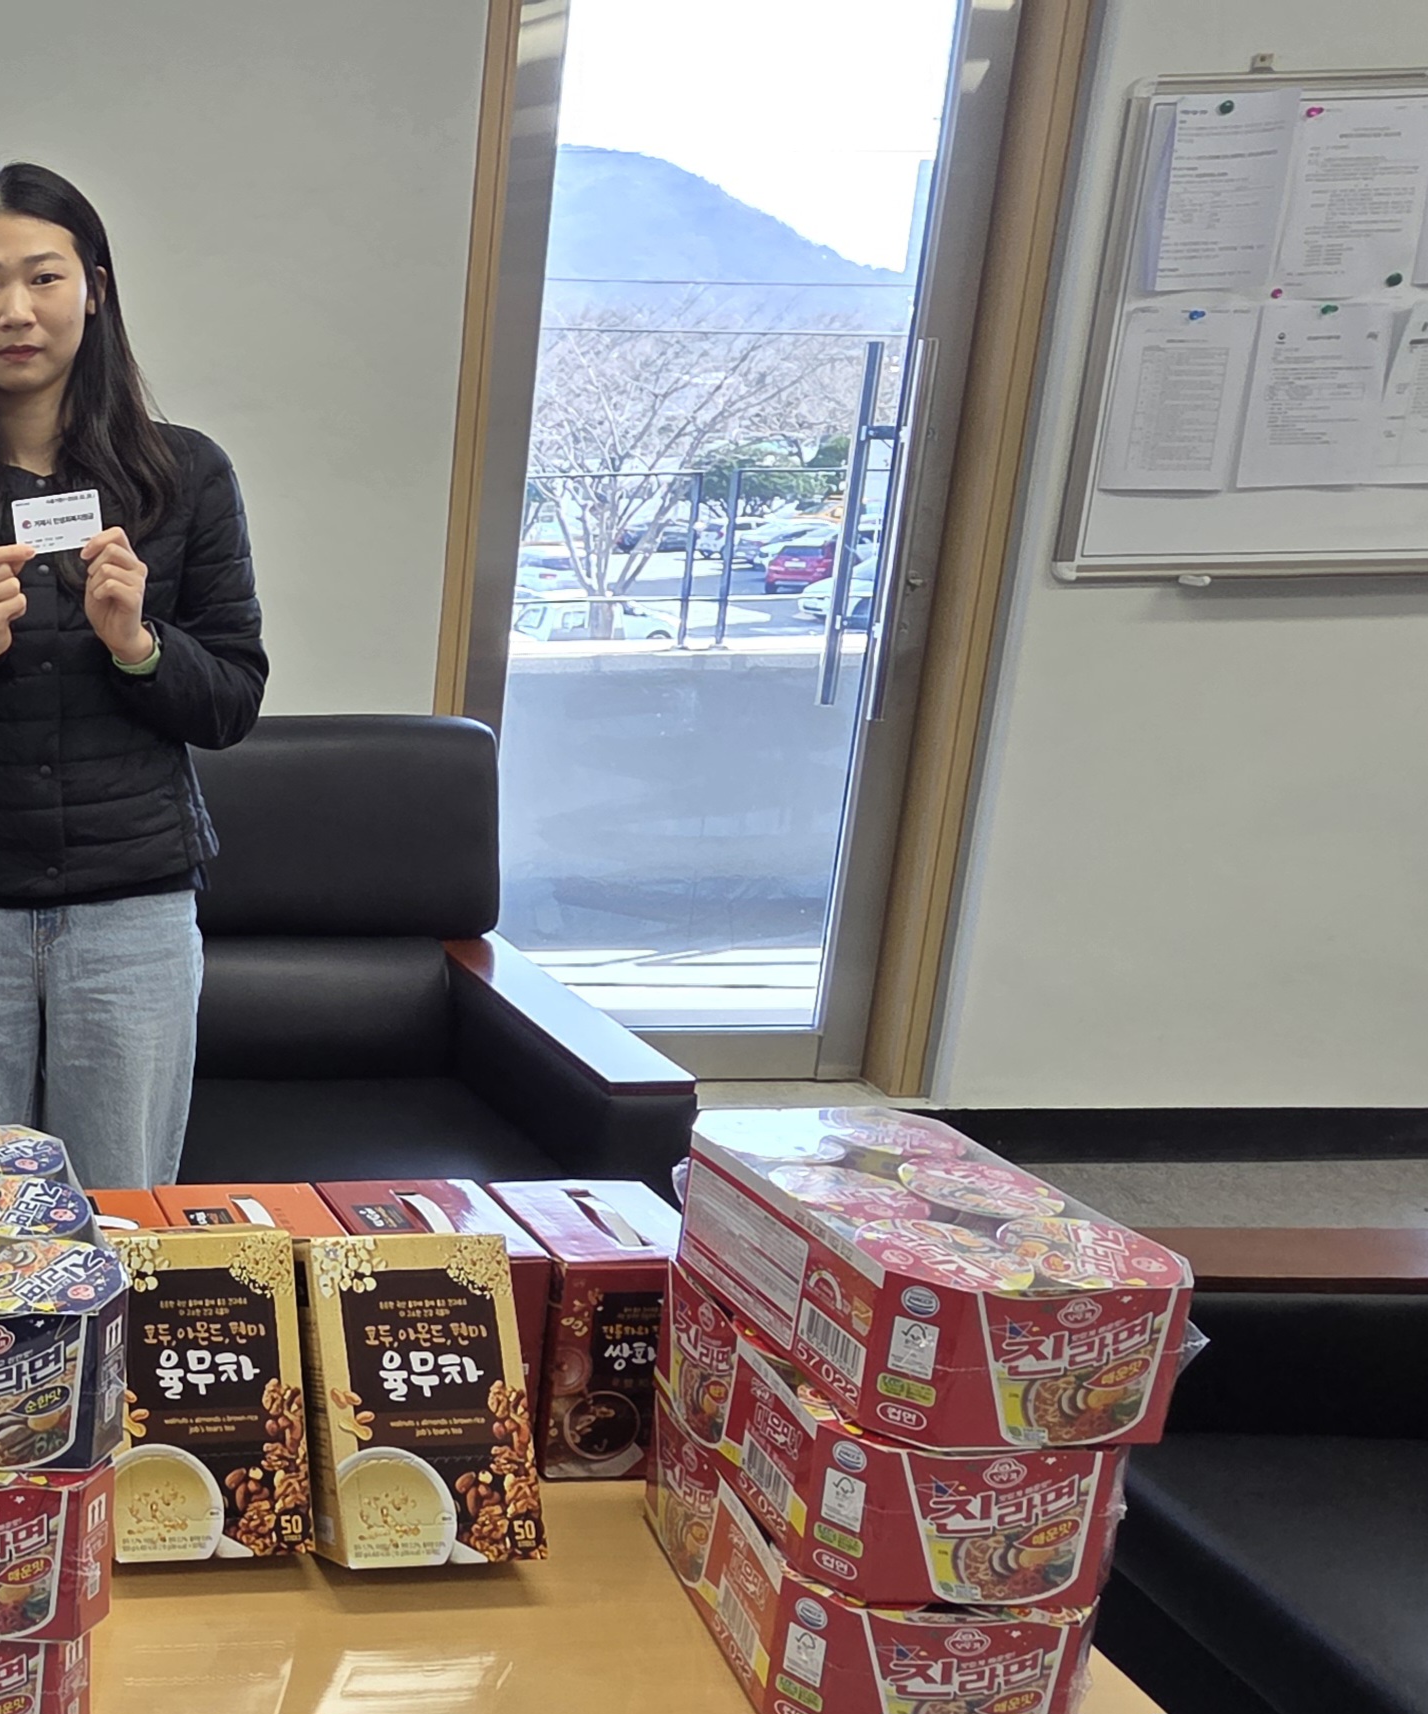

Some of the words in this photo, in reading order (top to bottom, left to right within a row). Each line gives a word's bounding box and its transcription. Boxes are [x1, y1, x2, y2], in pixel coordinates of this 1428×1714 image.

[999, 1312, 1155, 1380] 진라면
[155, 1349, 261, 1400] 율무차
[378, 1350, 485, 1402] 율무차
[796, 1343, 821, 1367] 57
[821, 1363, 860, 1402] 022
[1099, 1359, 1144, 1386] 매운맛
[24, 1388, 62, 1414] 순한맛
[885, 1405, 918, 1427] 컵면
[738, 1471, 757, 1502] 57
[757, 1495, 788, 1536] 022
[929, 1473, 1080, 1537] 진라면
[280, 1514, 303, 1535] 50
[512, 1519, 536, 1540] 50
[1031, 1519, 1074, 1546] 매운맛
[7, 1558, 45, 1582] 매운맛
[822, 1555, 850, 1576] 컵면
[886, 1647, 1045, 1701] 진라면
[992, 1690, 1036, 1714] 매운맛
